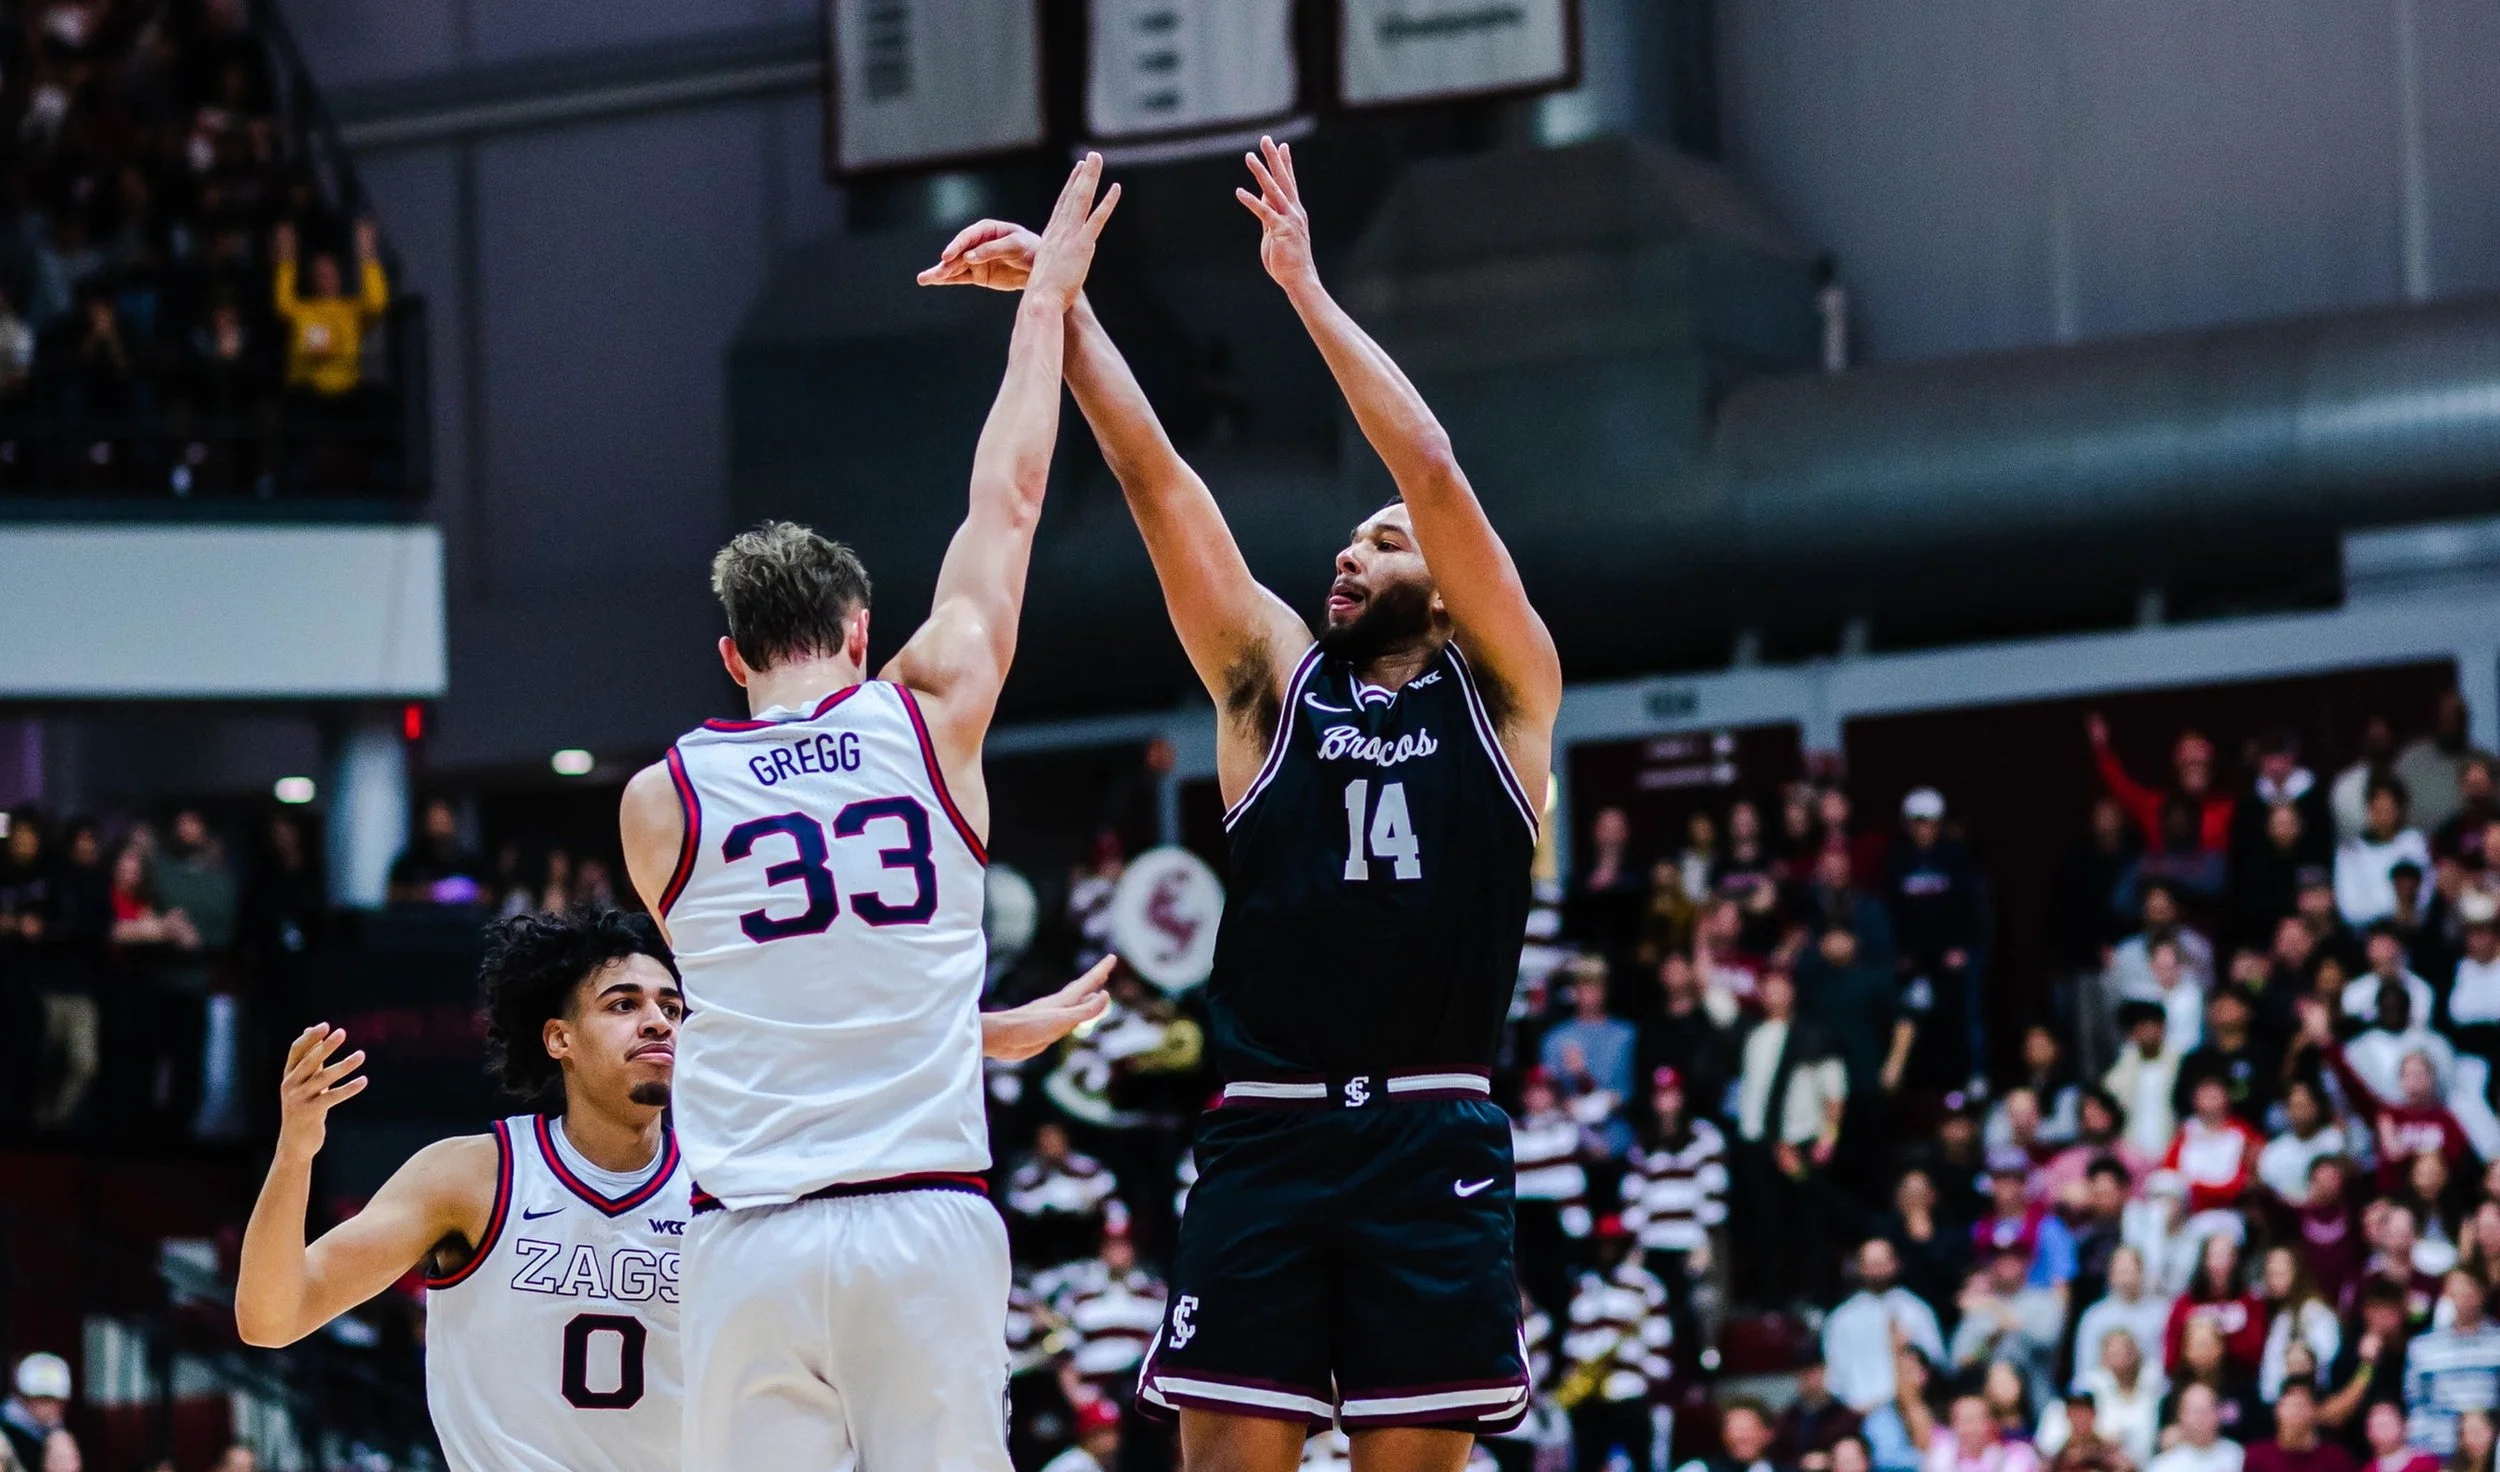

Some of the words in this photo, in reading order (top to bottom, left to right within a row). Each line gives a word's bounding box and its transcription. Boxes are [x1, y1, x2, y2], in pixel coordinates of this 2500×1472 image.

[749, 732, 861, 786] GREGG
[722, 795, 938, 944] 33
[1344, 779, 1422, 880] 14
[648, 1218, 686, 1236] WCC
[561, 1313, 647, 1409] 0
